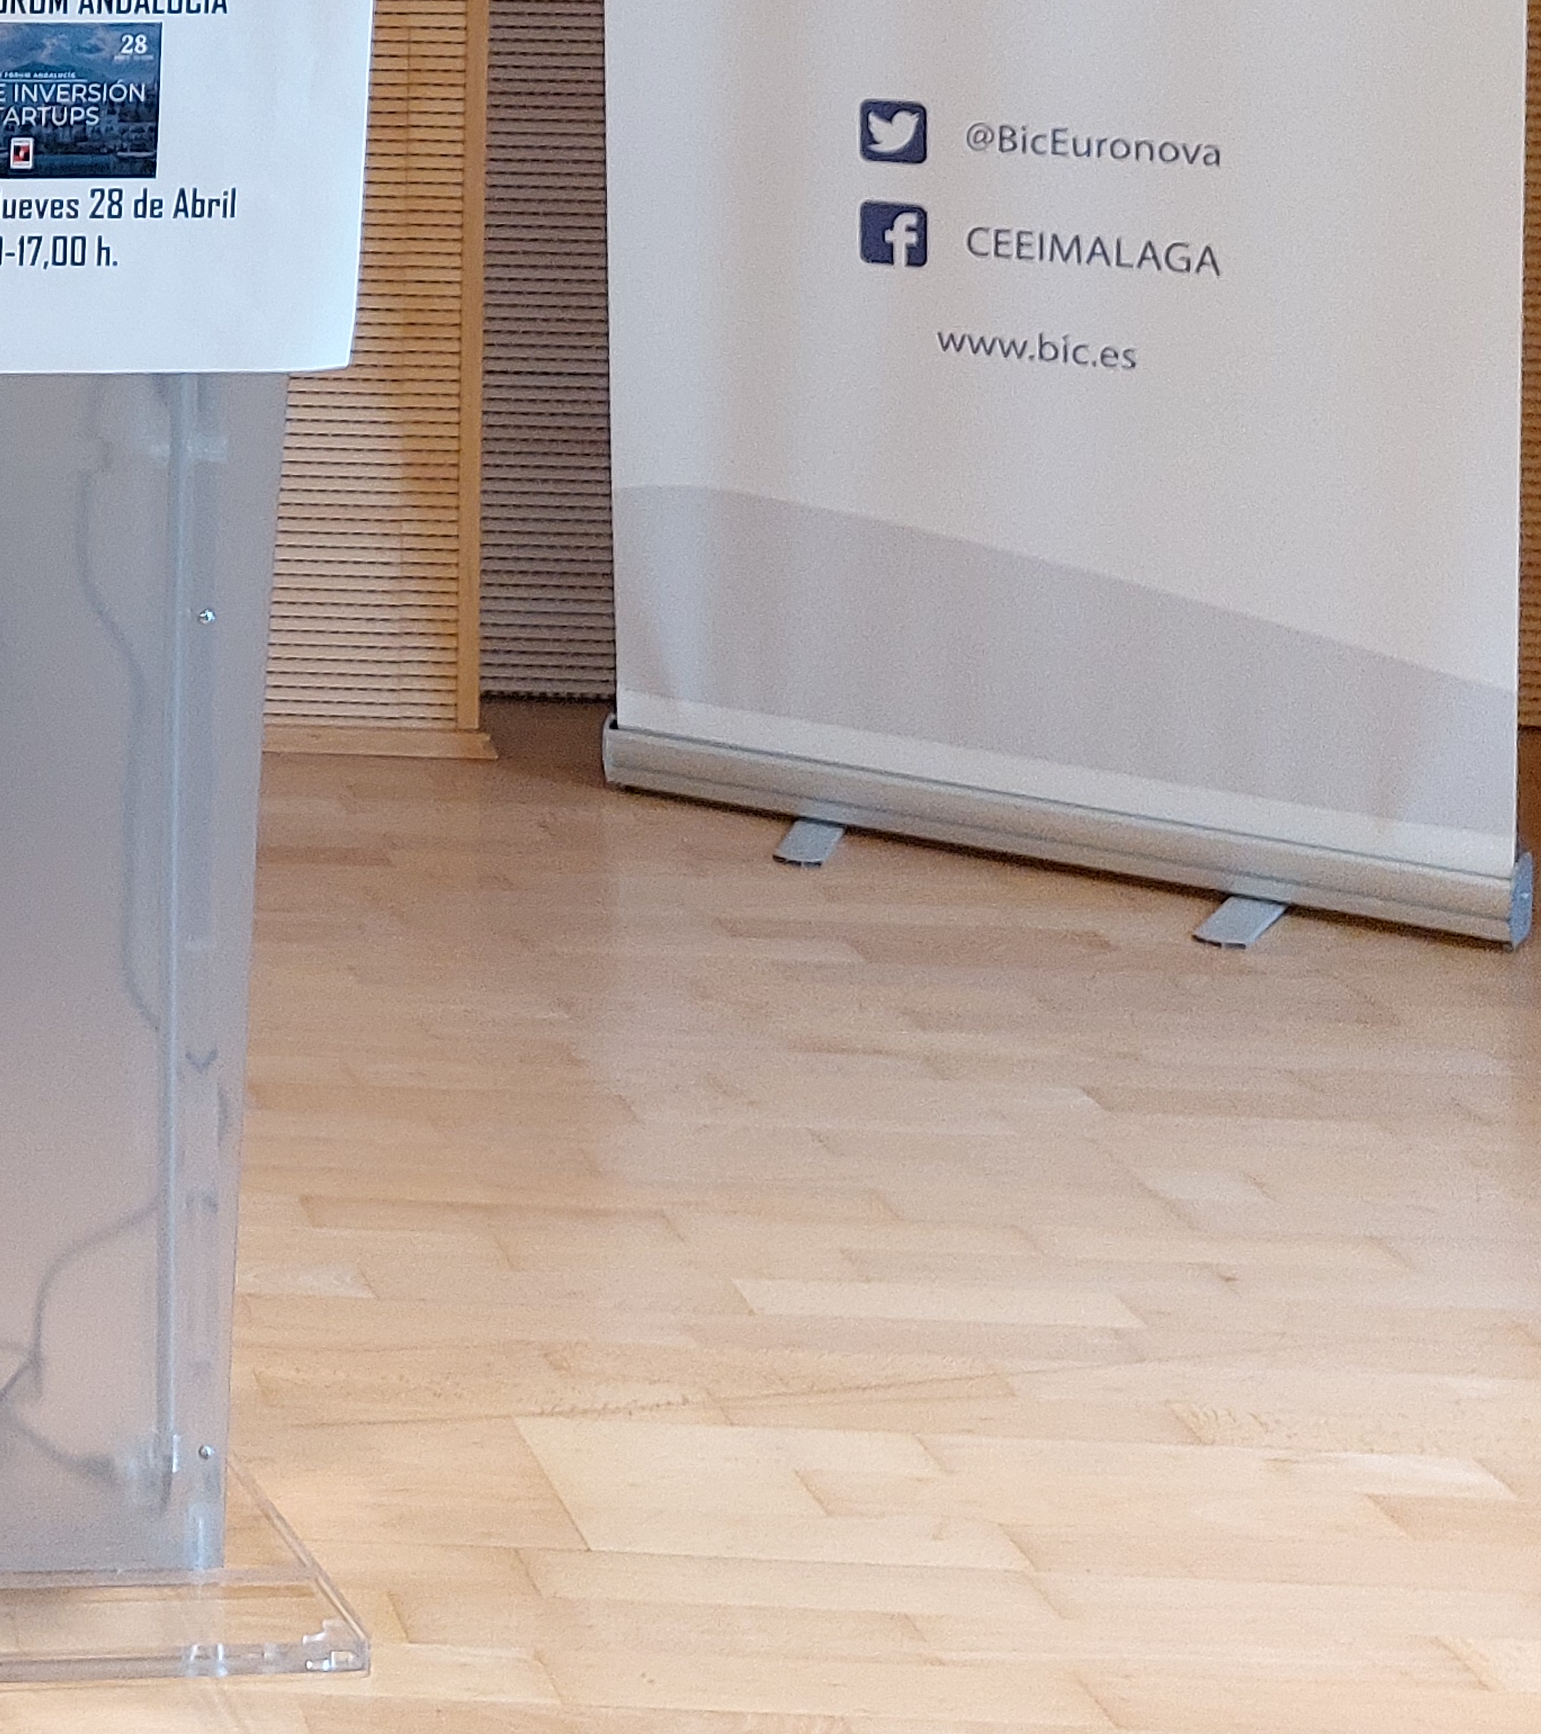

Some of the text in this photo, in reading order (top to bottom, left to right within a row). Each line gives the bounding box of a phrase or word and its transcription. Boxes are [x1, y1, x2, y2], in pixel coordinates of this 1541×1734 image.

[120, 33, 149, 54] 28
[14, 80, 146, 103] INVERSIÓN
[966, 122, 1221, 168] @BicEuronova
[89, 188, 124, 219] 28
[133, 187, 164, 219] de
[172, 187, 237, 219] Abril
[96, 235, 118, 267] h.
[966, 226, 1221, 276] CEEIMALAGA
[936, 330, 1138, 370] www.bic.es
